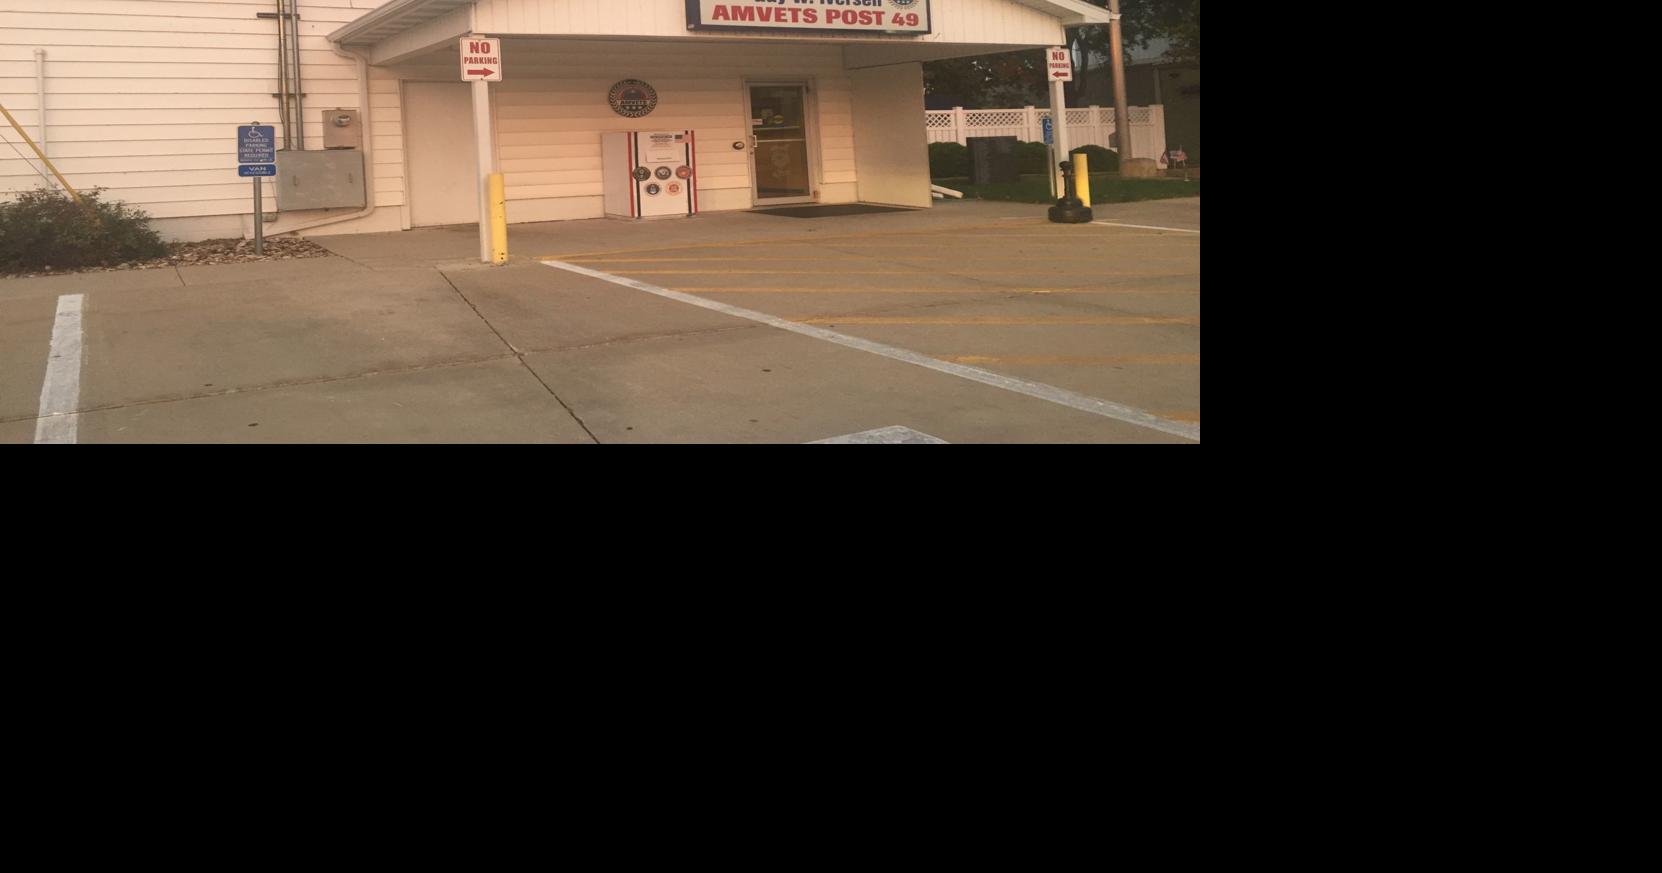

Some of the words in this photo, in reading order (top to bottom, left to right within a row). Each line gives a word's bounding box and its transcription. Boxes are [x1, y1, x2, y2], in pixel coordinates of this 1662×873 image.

[712, 5, 818, 24] AMVETS
[825, 9, 886, 26] POST
[891, 13, 919, 27] 49
[469, 41, 491, 54] NO
[463, 56, 498, 65] PARKING
[1052, 51, 1065, 61] NO
